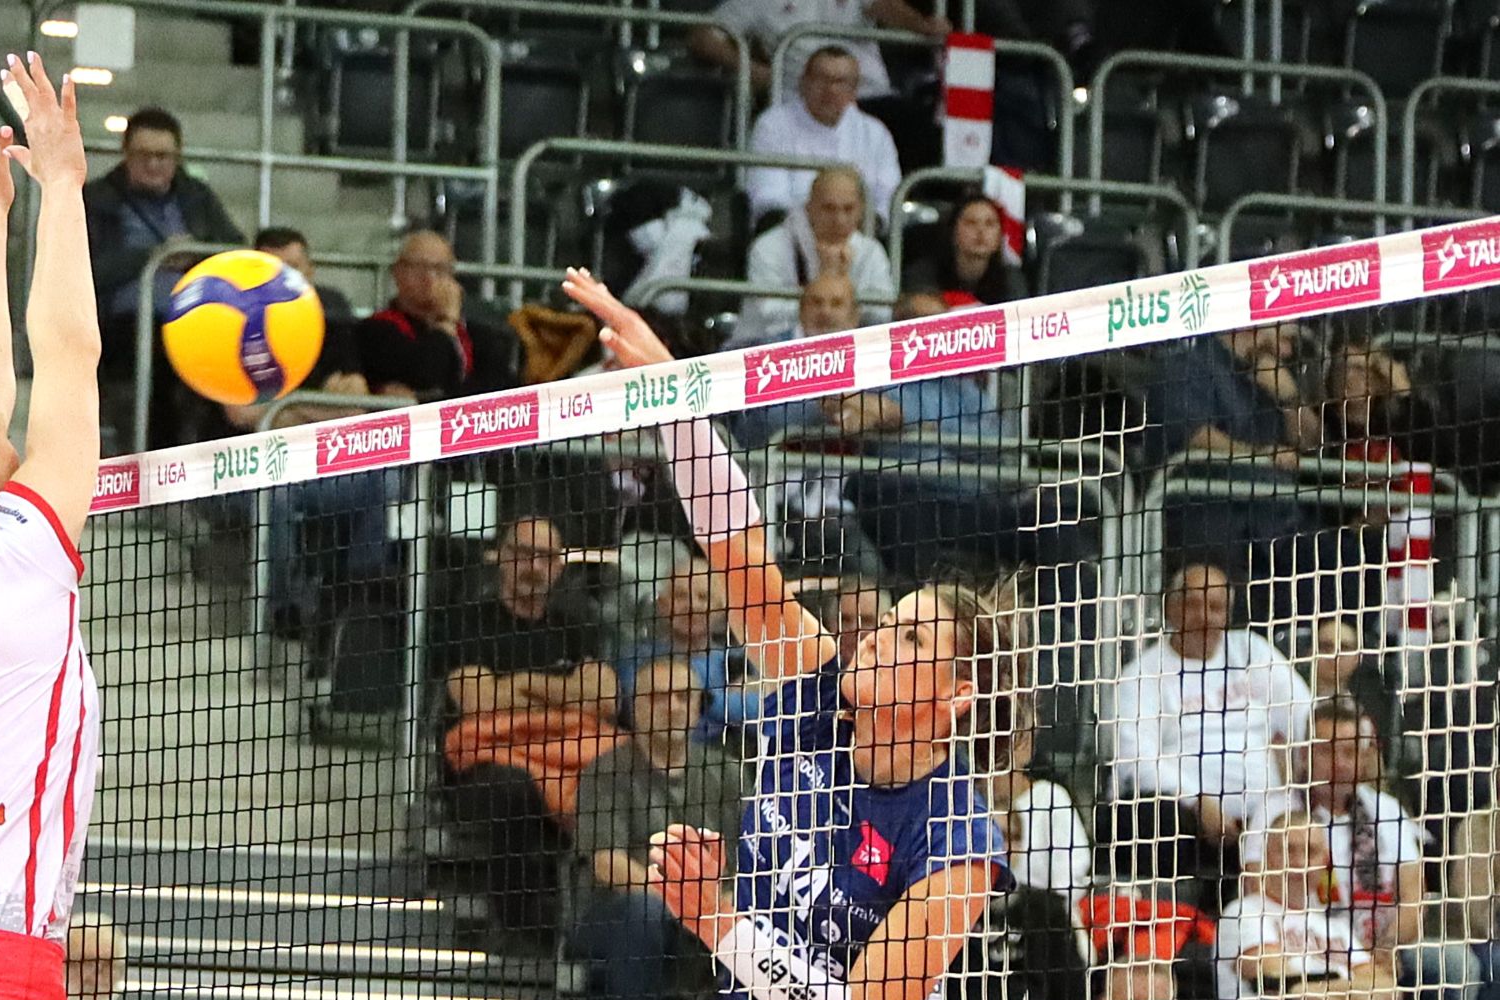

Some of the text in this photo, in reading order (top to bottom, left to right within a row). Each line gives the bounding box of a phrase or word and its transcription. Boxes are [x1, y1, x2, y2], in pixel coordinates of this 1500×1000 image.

[92, 472, 133, 498] URON
[157, 461, 186, 486] LIGA
[213, 445, 259, 489] plus
[345, 426, 403, 456] TAURON
[471, 403, 531, 435] TAURON
[559, 392, 593, 419] LIGA
[625, 372, 678, 421] plus
[780, 350, 846, 383] TAURON
[927, 324, 996, 357] TAURON
[1031, 311, 1070, 340] LIGA
[1107, 286, 1170, 342] plus
[1290, 259, 1370, 297] TAURON
